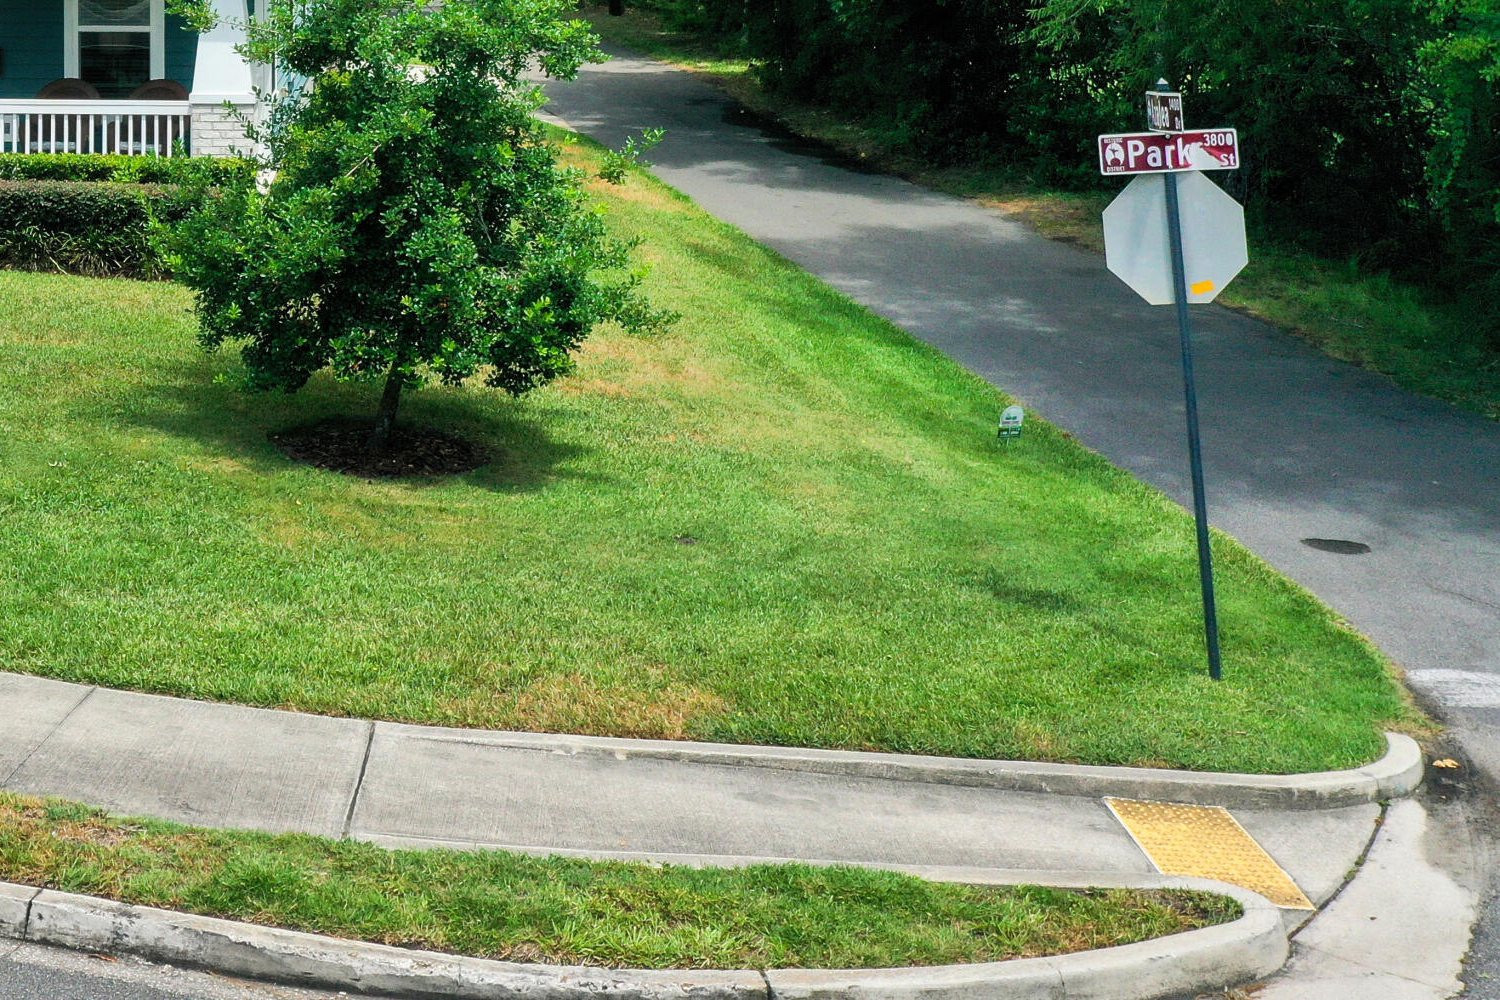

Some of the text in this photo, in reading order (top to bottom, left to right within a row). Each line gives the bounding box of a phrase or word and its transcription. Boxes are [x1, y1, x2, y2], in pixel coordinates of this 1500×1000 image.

[1203, 133, 1233, 147] 3800
[1127, 138, 1236, 168] Park St
